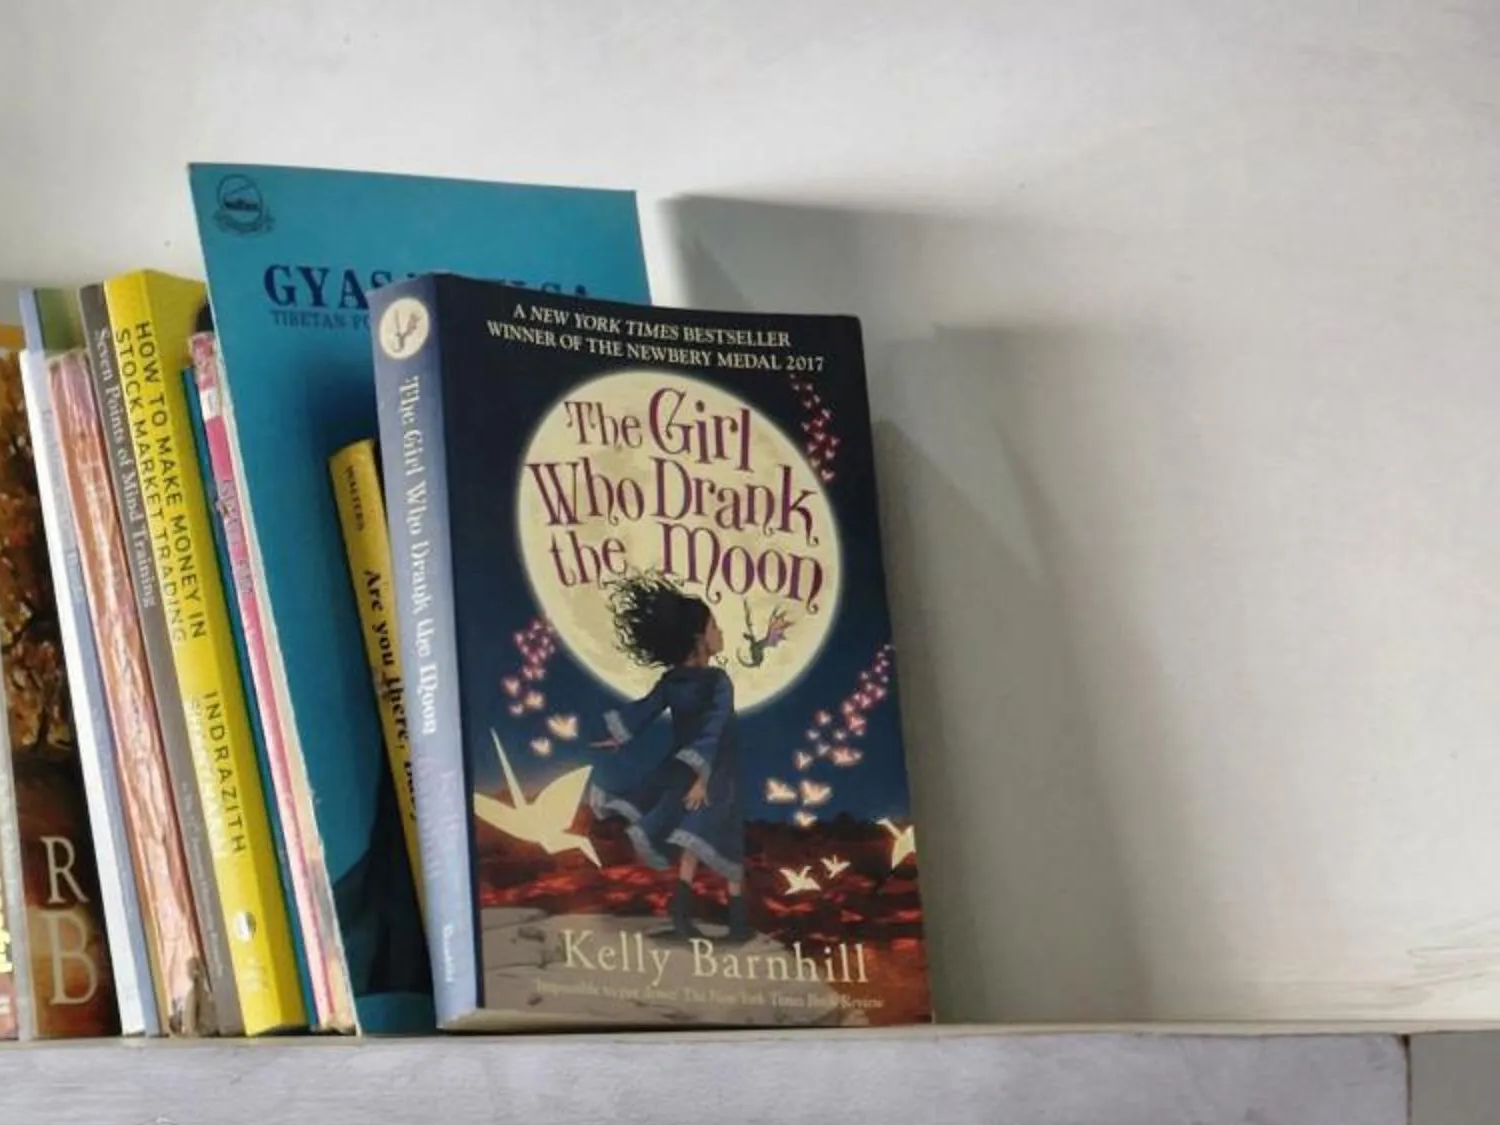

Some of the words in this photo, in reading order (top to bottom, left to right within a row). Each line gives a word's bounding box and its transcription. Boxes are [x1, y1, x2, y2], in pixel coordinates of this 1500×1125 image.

[264, 263, 392, 311] GYAS
[272, 308, 346, 331] TIBETAN
[486, 319, 557, 348] WINNER
[559, 332, 583, 352] OF
[585, 336, 624, 358] THE
[626, 341, 714, 368] NEWBERY
[717, 354, 782, 371] MEDAL
[785, 355, 824, 373] 2017
[512, 303, 527, 320] A
[530, 307, 569, 325] NEW
[573, 313, 621, 335] YORK
[625, 320, 679, 341] TIMES
[683, 327, 792, 348] BESTSELLER
[93, 328, 119, 382] Seven
[135, 323, 162, 385] HOW
[102, 386, 129, 446] Points
[150, 392, 169, 428] TO
[400, 376, 421, 424] The
[403, 428, 423, 475] Girl
[564, 402, 643, 449] The
[649, 387, 755, 474] Girl
[112, 448, 134, 470] of
[115, 328, 145, 411] STOCK
[132, 420, 162, 523] MARKET
[151, 528, 182, 643] TRADING
[156, 437, 185, 508] MAKE
[118, 473, 145, 521] Mind
[405, 480, 428, 535] Who
[525, 457, 645, 527] Who
[648, 456, 819, 547] Drank
[127, 524, 159, 609] Training
[168, 515, 203, 602] MONEY
[410, 541, 433, 616] Drank
[548, 530, 628, 590] the
[655, 521, 823, 615] Moon
[363, 569, 385, 612] Are
[189, 611, 211, 640] IN
[372, 621, 395, 667] you
[415, 618, 437, 657] the
[416, 665, 439, 735] Moon
[202, 690, 248, 856] INDRAZITH
[558, 928, 671, 986] Kelly
[689, 937, 869, 984] Barnhill
